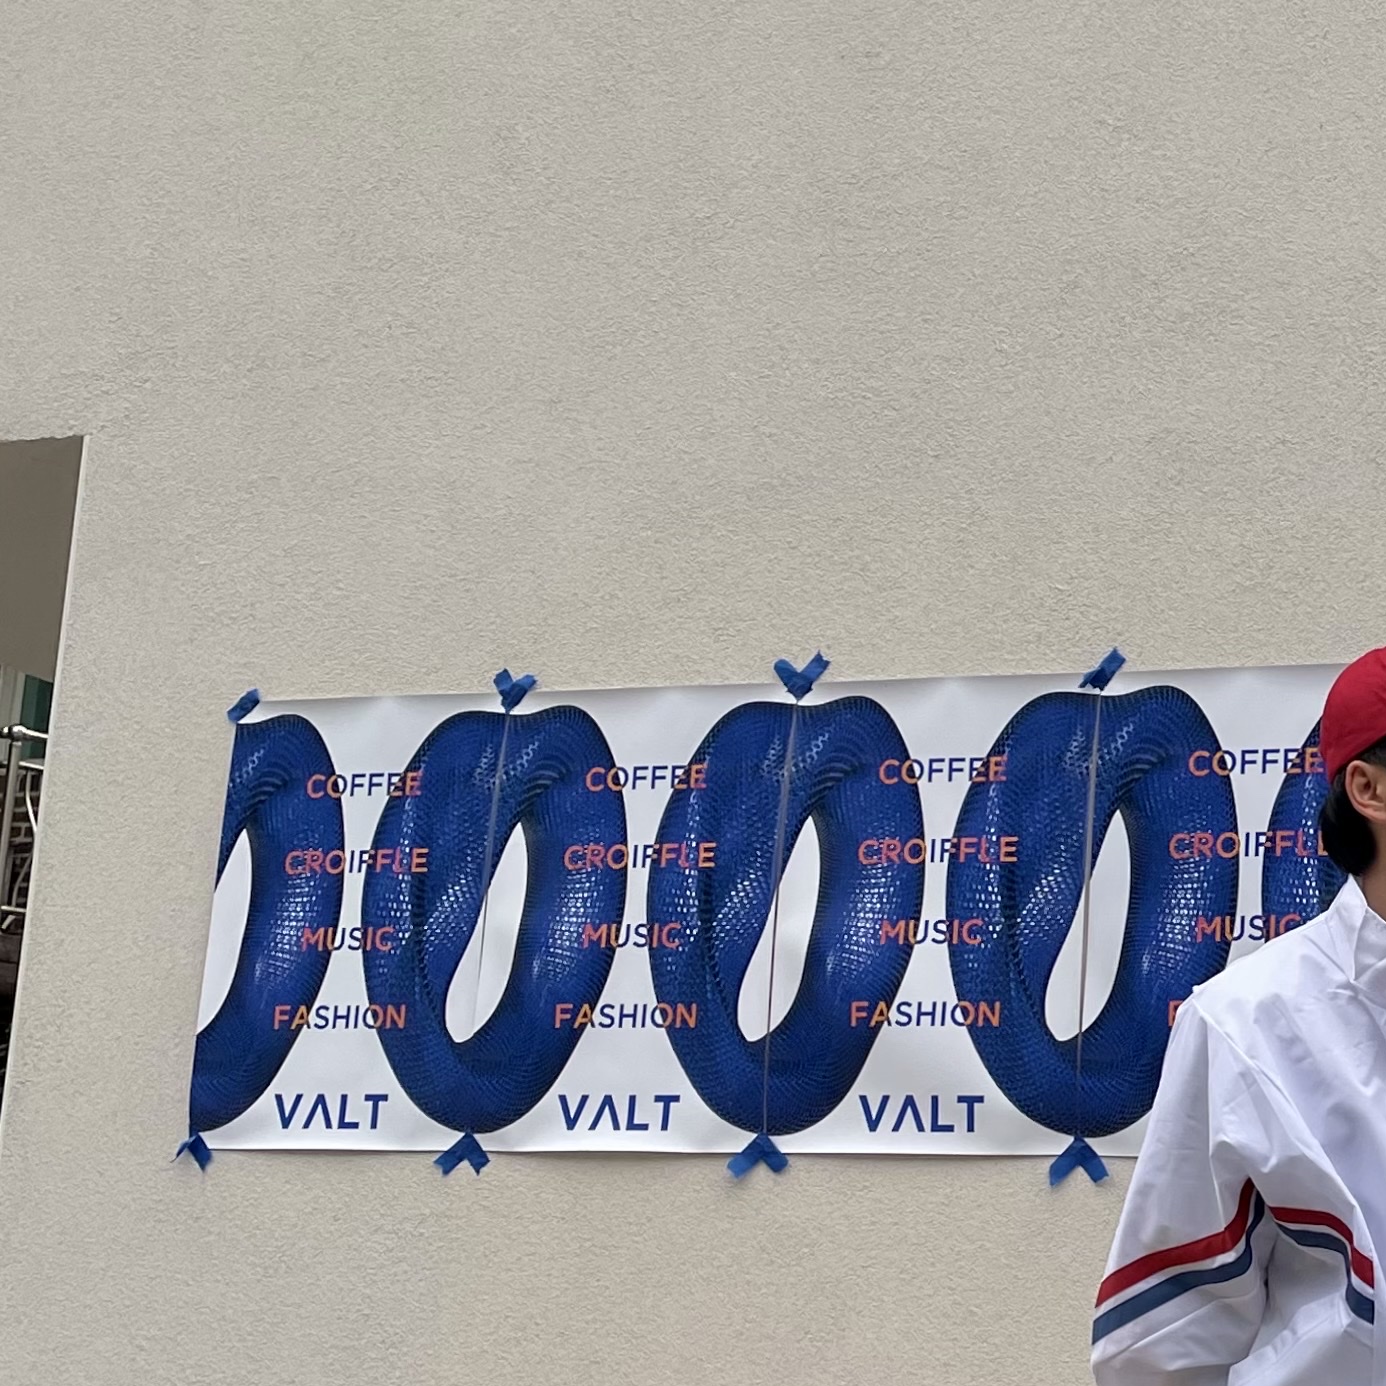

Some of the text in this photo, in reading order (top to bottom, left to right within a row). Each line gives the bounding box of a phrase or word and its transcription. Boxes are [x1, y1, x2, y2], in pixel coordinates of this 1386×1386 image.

[878, 756, 1009, 785] COFFEE
[1187, 747, 1325, 777] COFFEE
[307, 770, 423, 799] COFFEE
[585, 763, 708, 792] COFFEE
[283, 847, 429, 876] CROIFFLE
[563, 842, 717, 872] CROIFFLE
[856, 836, 1020, 866] CROIFFLE
[300, 926, 396, 952] MUSIC
[581, 922, 683, 950] MUSIC
[879, 918, 984, 947] MUSIC
[272, 1004, 407, 1031] FASHION
[553, 1002, 699, 1030] FASHION
[849, 1000, 1001, 1028] FASHION
[274, 1092, 389, 1131] VALT
[557, 1093, 681, 1132] VALT
[858, 1094, 985, 1134] VALT
